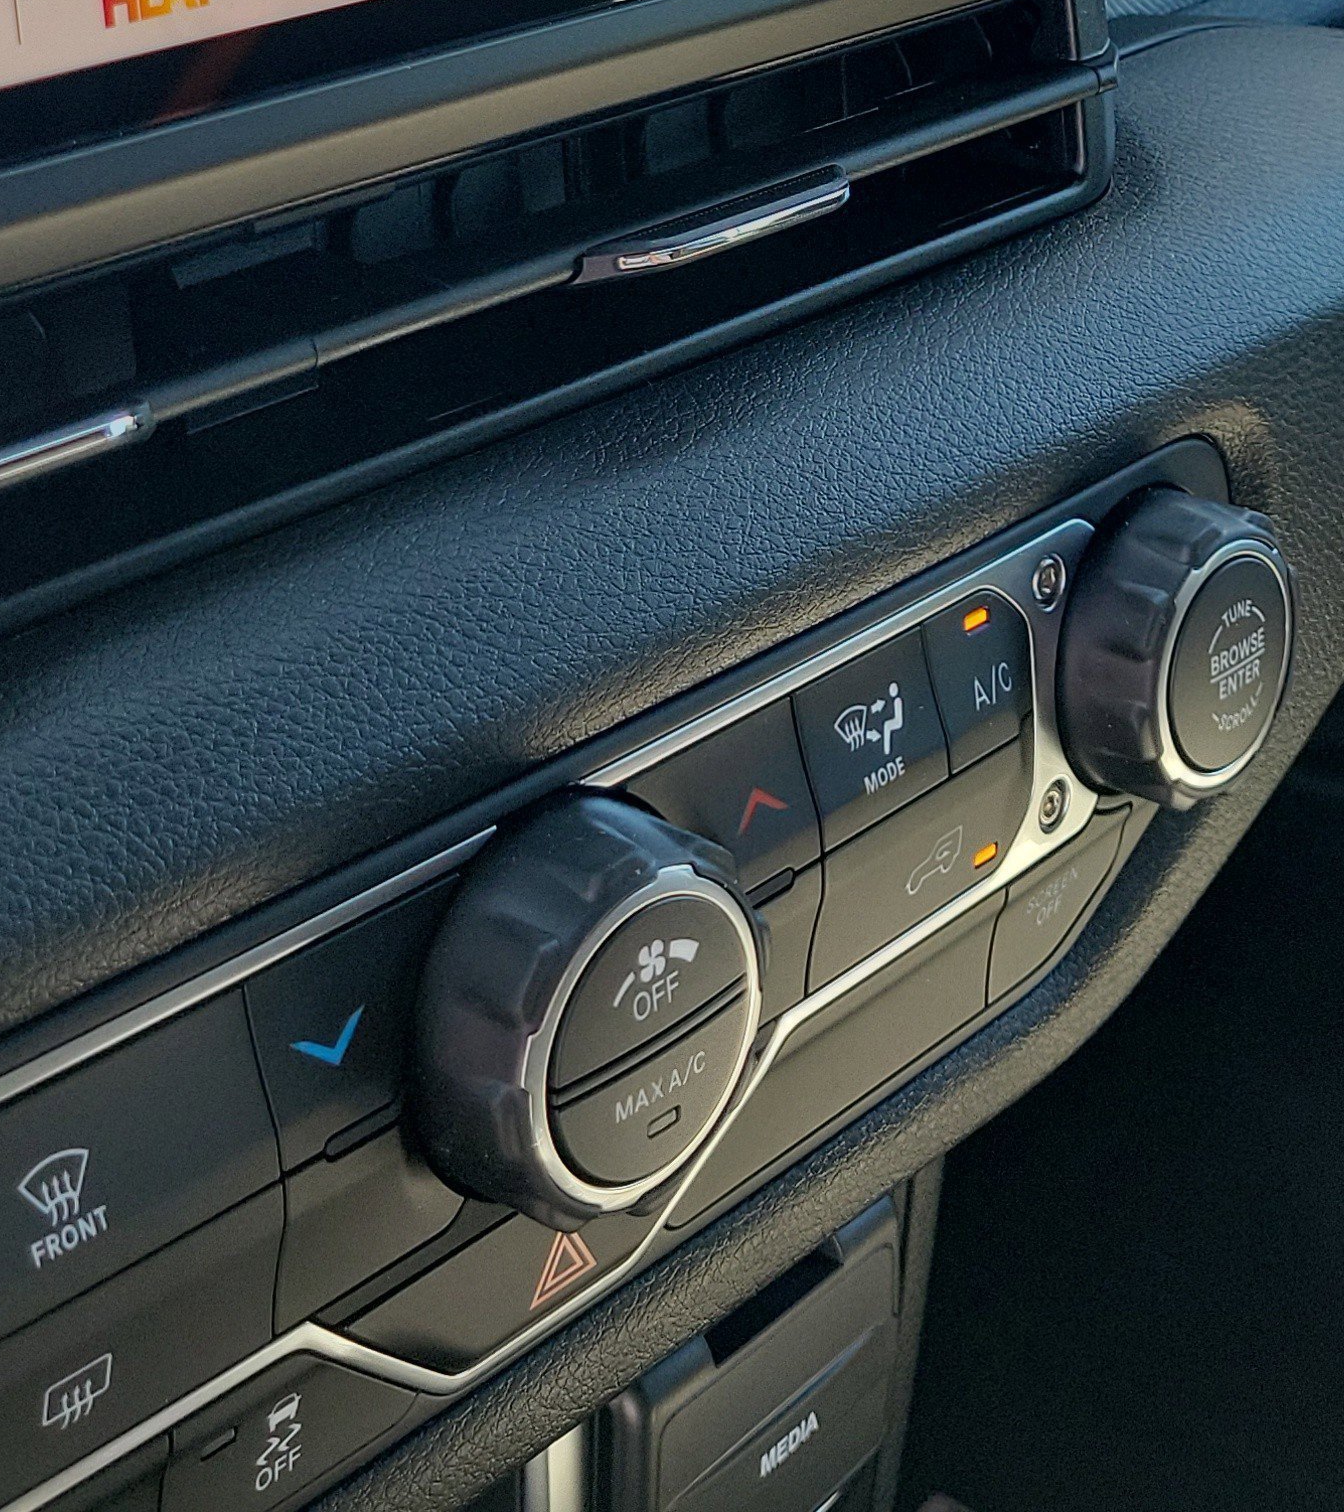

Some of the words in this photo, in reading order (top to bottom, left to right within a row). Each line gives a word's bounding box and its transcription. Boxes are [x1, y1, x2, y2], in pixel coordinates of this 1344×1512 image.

[1221, 599, 1253, 628] TUNE
[1210, 626, 1265, 677] BROWSE
[973, 668, 1014, 711] A/C
[1219, 658, 1261, 700] ENTER
[864, 755, 906, 795] MODE
[632, 970, 680, 1023] OFF
[614, 1079, 666, 1124] MAX
[667, 1050, 707, 1092] A/C
[30, 1204, 109, 1269] FRONT
[255, 1445, 303, 1492] OFF
[760, 1410, 819, 1478] MEDIA
